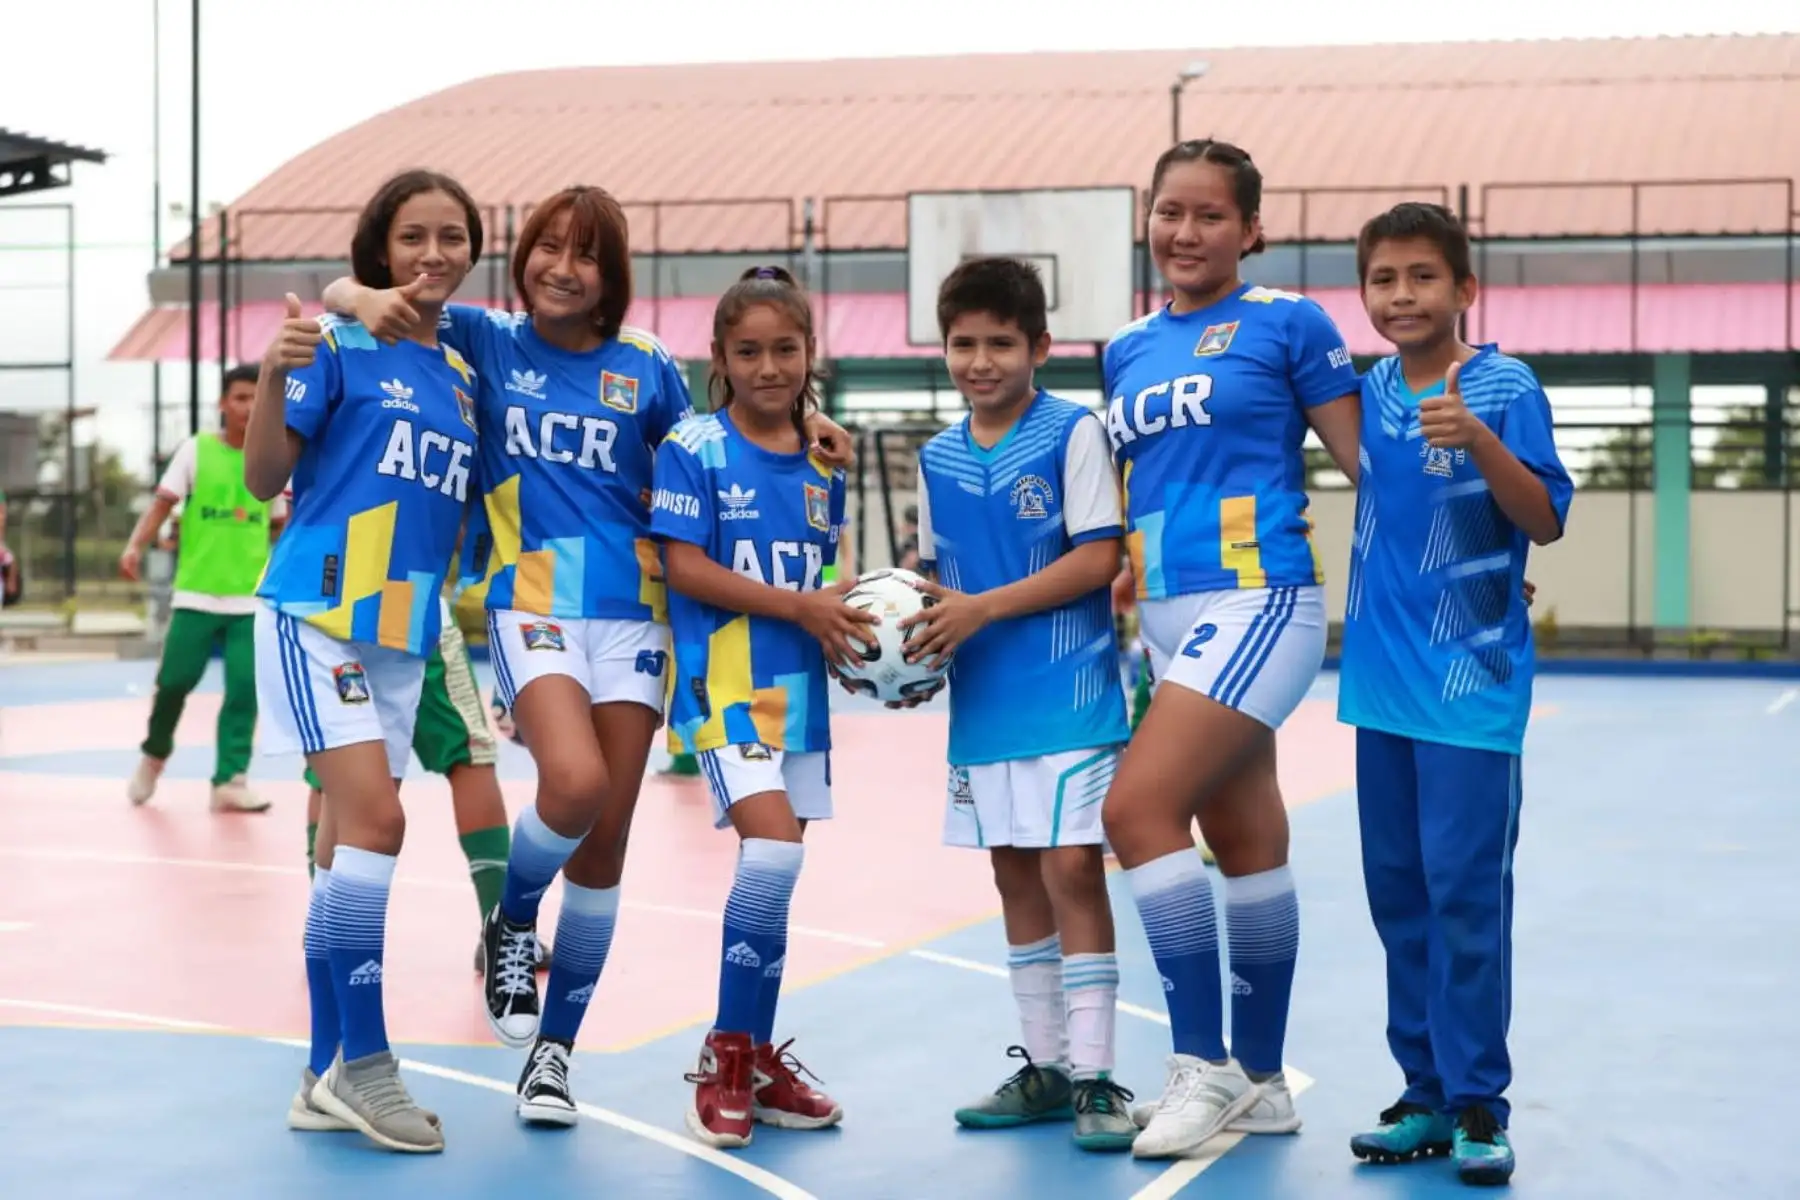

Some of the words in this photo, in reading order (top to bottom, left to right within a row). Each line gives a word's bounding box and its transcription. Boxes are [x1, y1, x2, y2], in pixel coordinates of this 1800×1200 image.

[505, 405, 618, 474] ACR
[1106, 373, 1213, 452] ACR
[377, 418, 472, 503] ACR
[719, 506, 760, 521] adidas
[731, 538, 823, 594] ACR
[1182, 622, 1218, 659] 2
